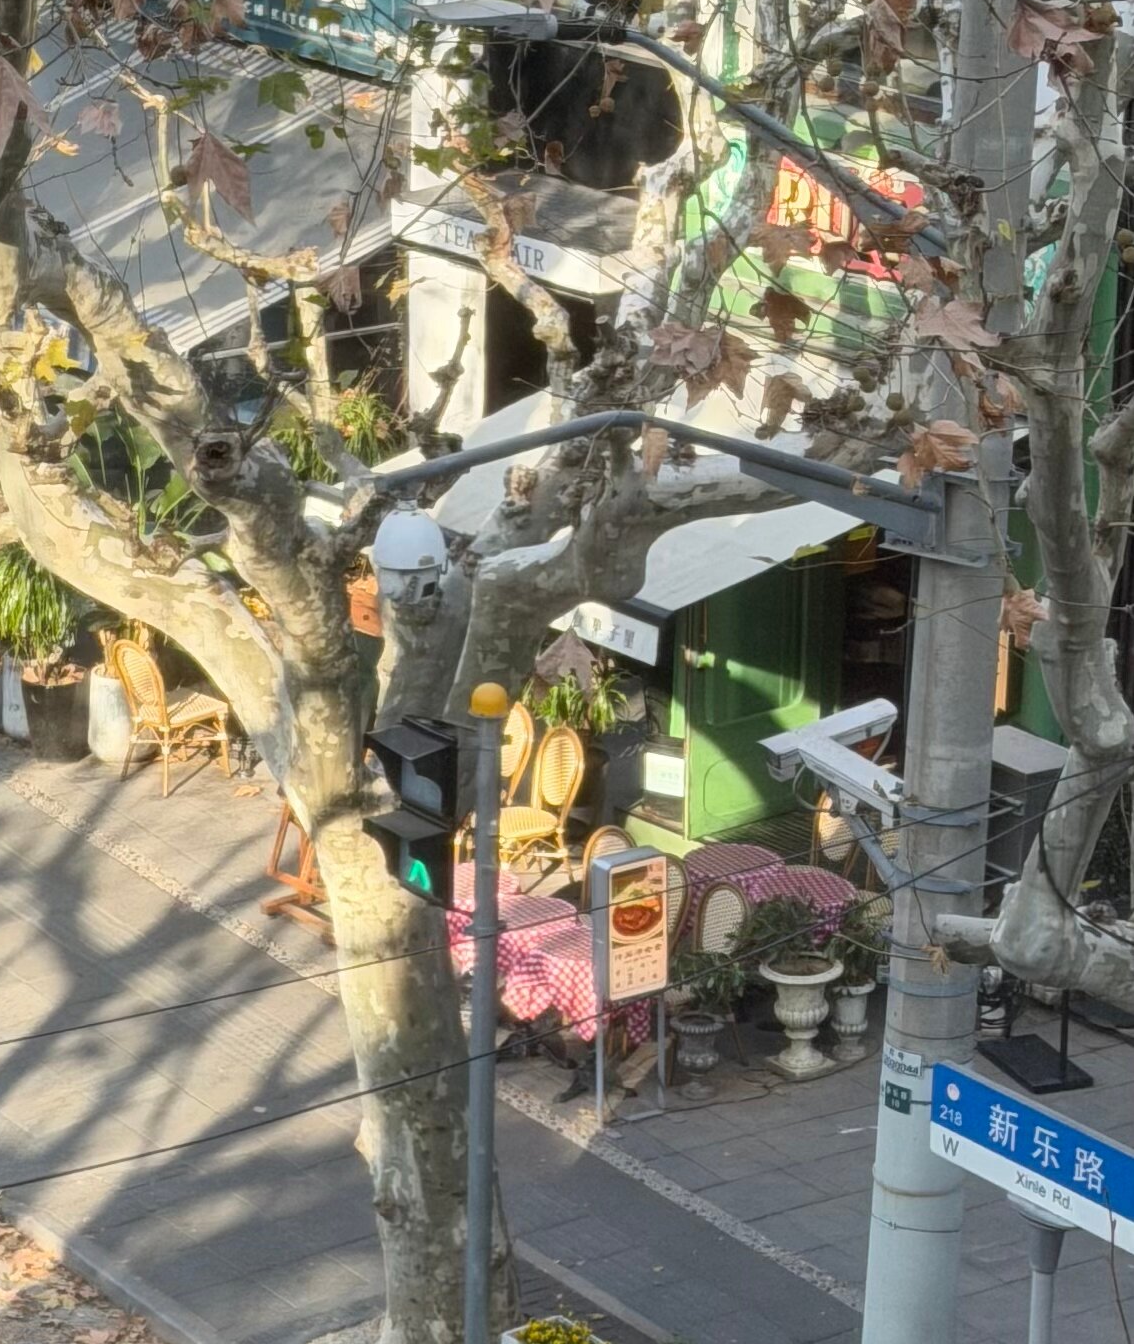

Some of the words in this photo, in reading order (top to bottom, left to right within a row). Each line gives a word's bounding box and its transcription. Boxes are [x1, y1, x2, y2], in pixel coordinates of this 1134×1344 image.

[939, 1104, 963, 1127] 218
[943, 1134, 959, 1157] W
[988, 1103, 1106, 1194] 新乐路
[1015, 1170, 1047, 1198] Xinle
